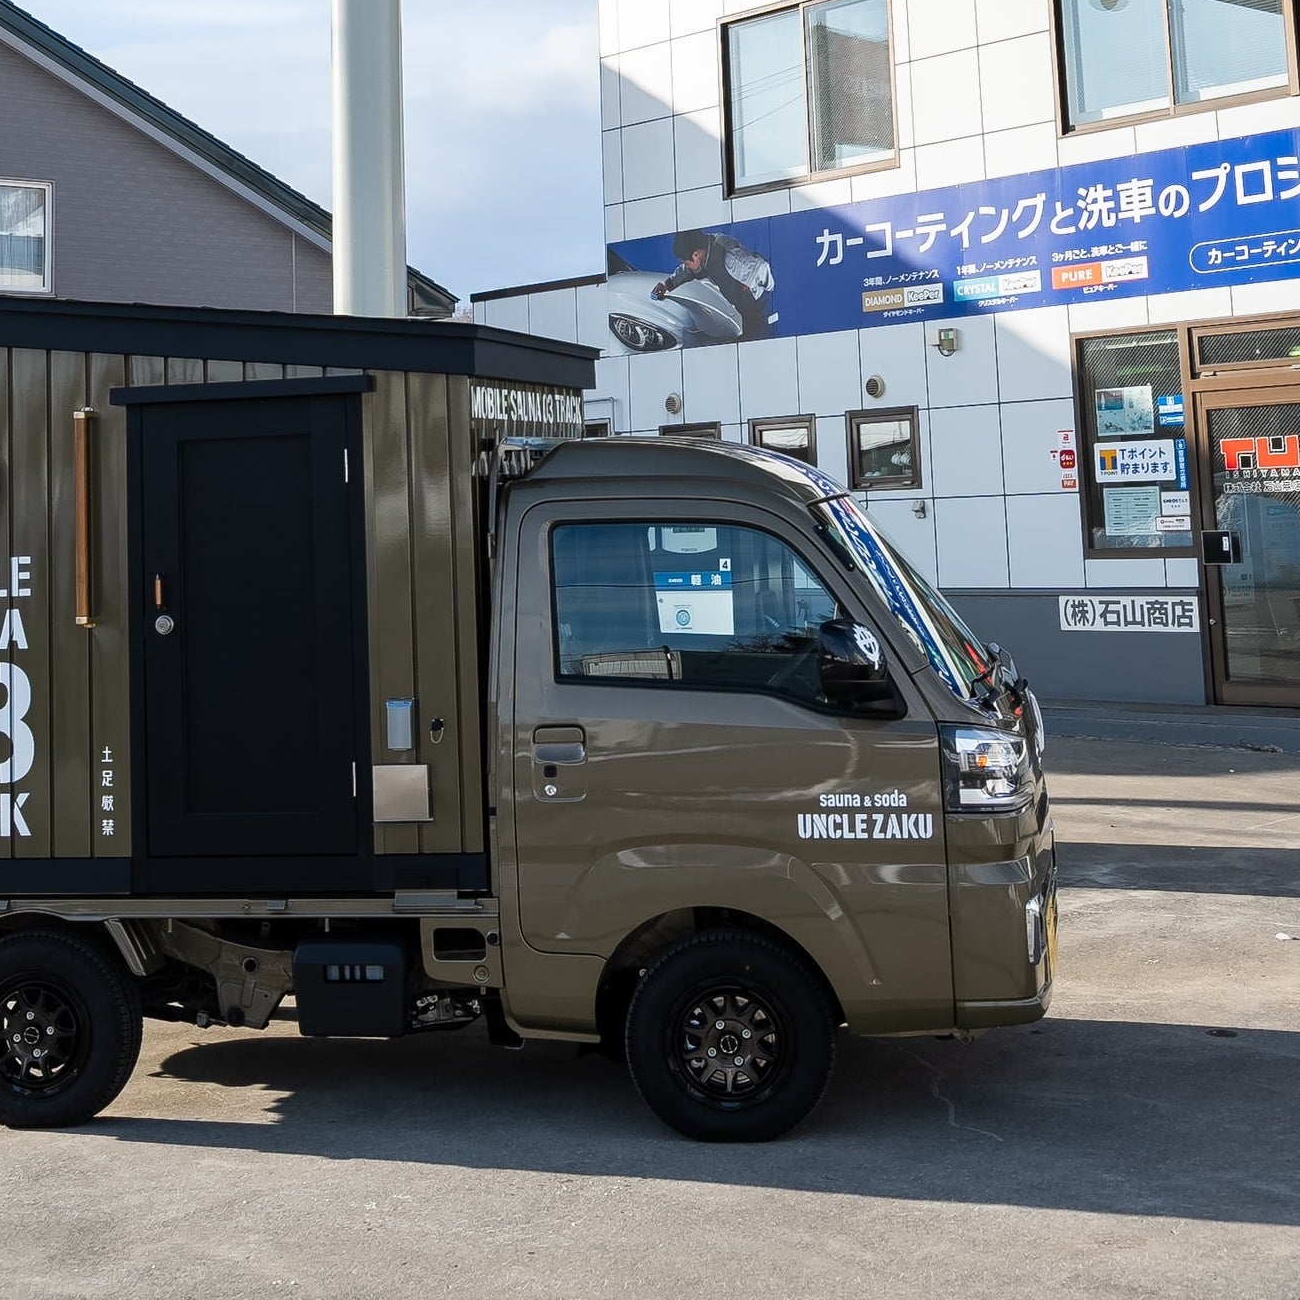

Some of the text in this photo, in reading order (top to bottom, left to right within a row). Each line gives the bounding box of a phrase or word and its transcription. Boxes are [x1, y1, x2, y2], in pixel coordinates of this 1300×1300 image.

[1061, 268, 1093, 283] PURE
[957, 281, 996, 296] CRYSTAL
[865, 293, 903, 307] DIAMOND
[471, 386, 582, 424] MOBILE SAUNA 03 TRACK
[1119, 447, 1167, 460] Tポイント
[722, 560, 729, 570] 4
[101, 745, 114, 836] 土足厳禁
[819, 789, 907, 808] sauna & soda
[797, 813, 933, 839] UNCLE ZAKU
